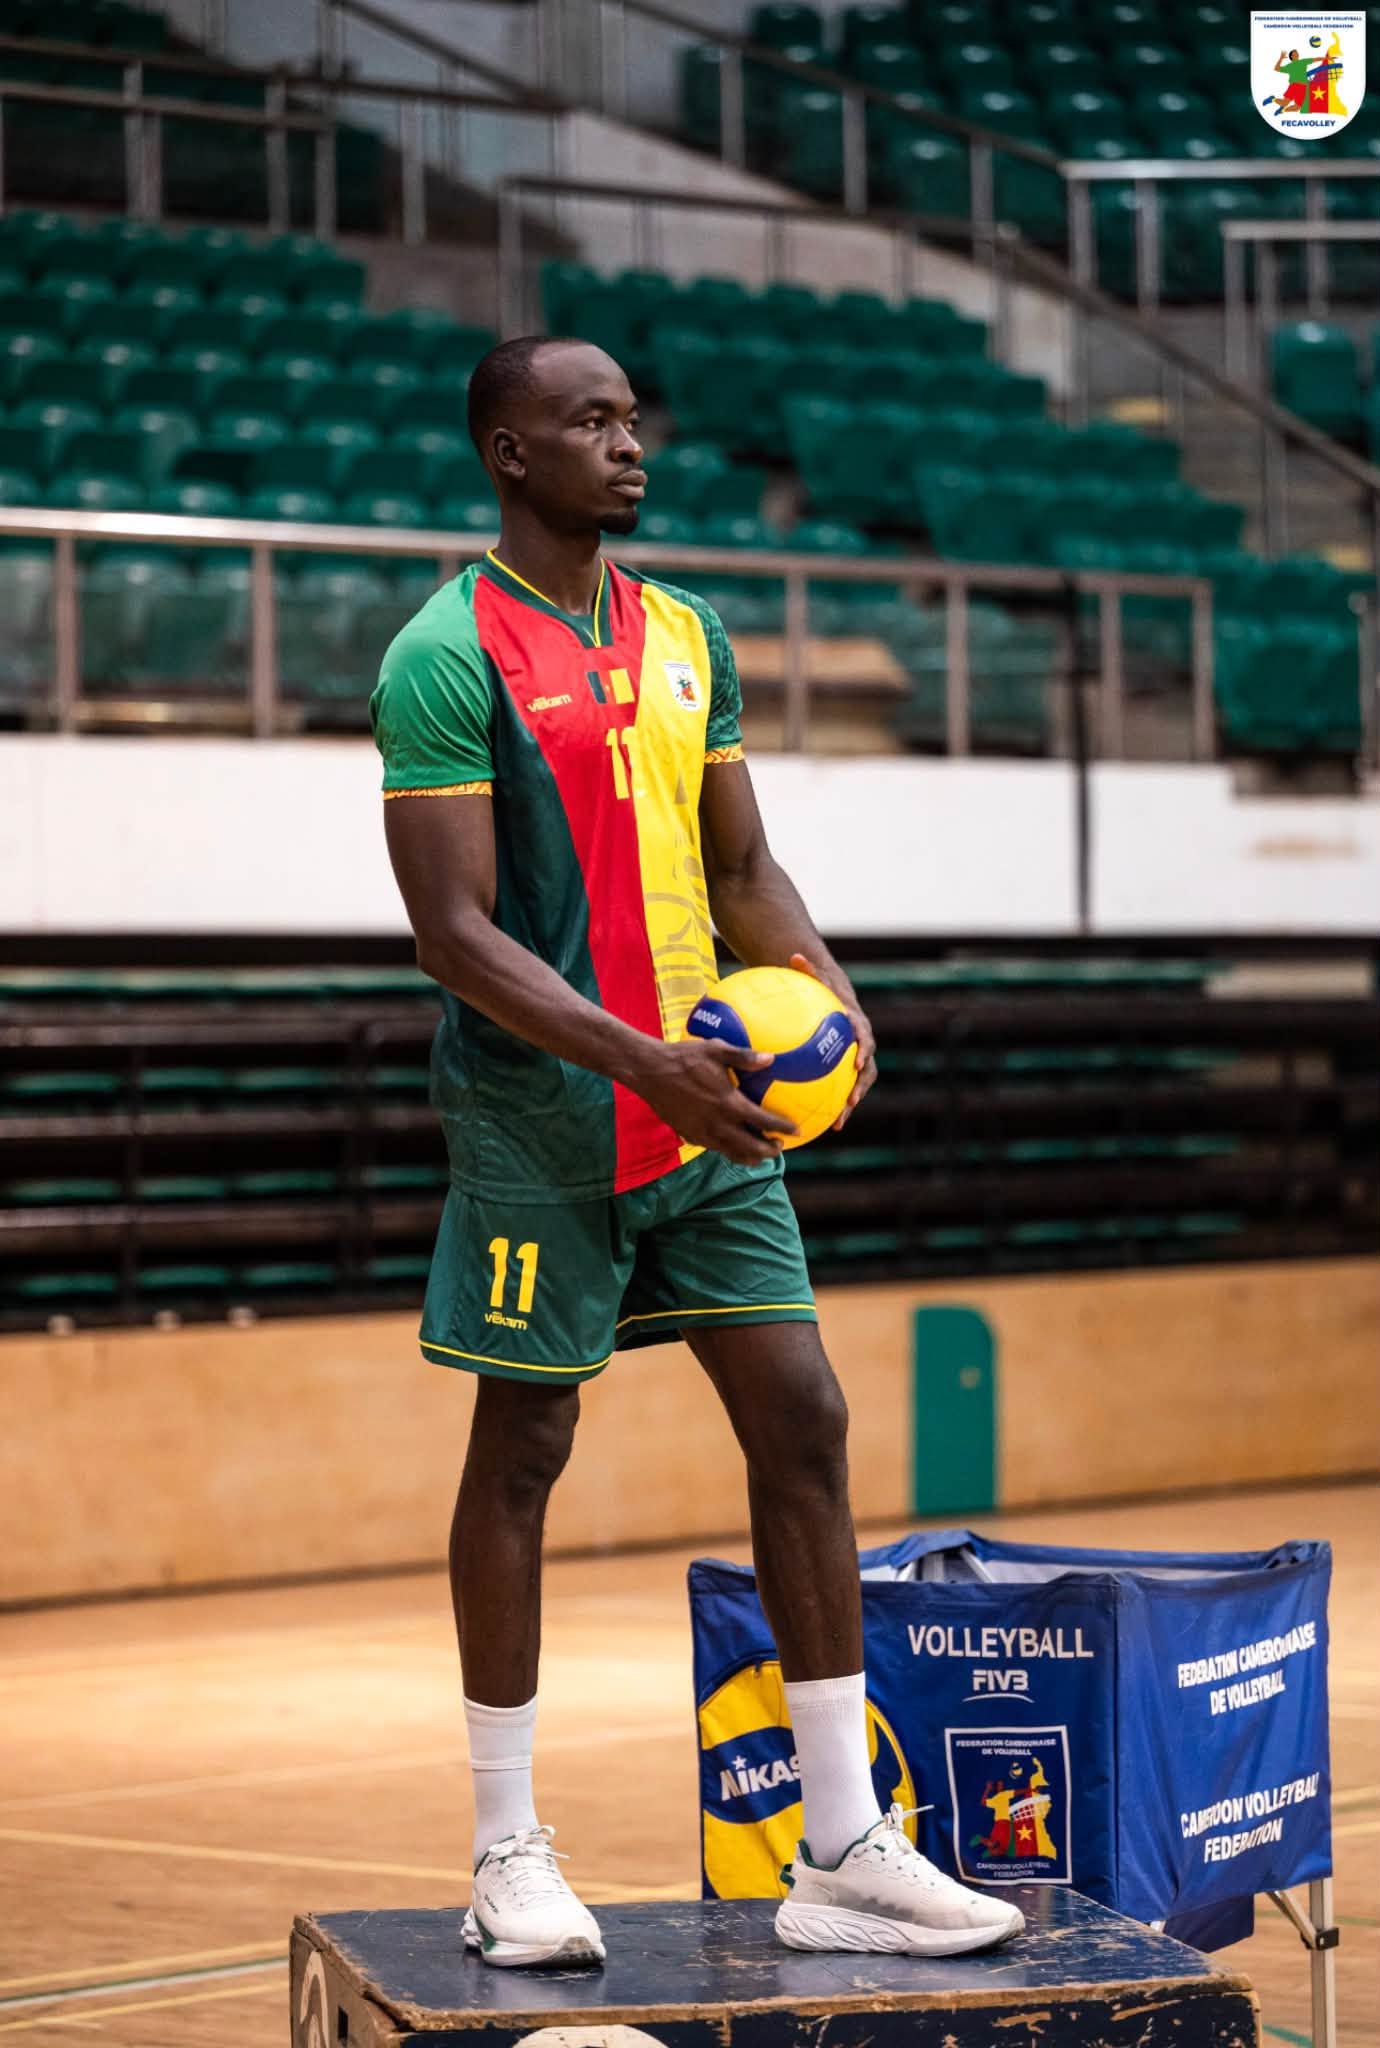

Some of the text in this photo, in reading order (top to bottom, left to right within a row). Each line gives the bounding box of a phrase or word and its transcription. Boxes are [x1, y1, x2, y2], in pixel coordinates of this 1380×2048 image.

[816, 1026, 840, 1056] FIVB
[488, 1237, 538, 1313] 11
[907, 1625, 1094, 1658] VOLLEYBALL
[972, 1669, 1029, 1691] FIVB
[1177, 1649, 1238, 1689] FEDERATION
[1210, 1669, 1286, 1716] DE VOLLEYBALL
[1180, 1798, 1243, 1839] CAMEROON
[1203, 1817, 1284, 1864] FEDERATION
